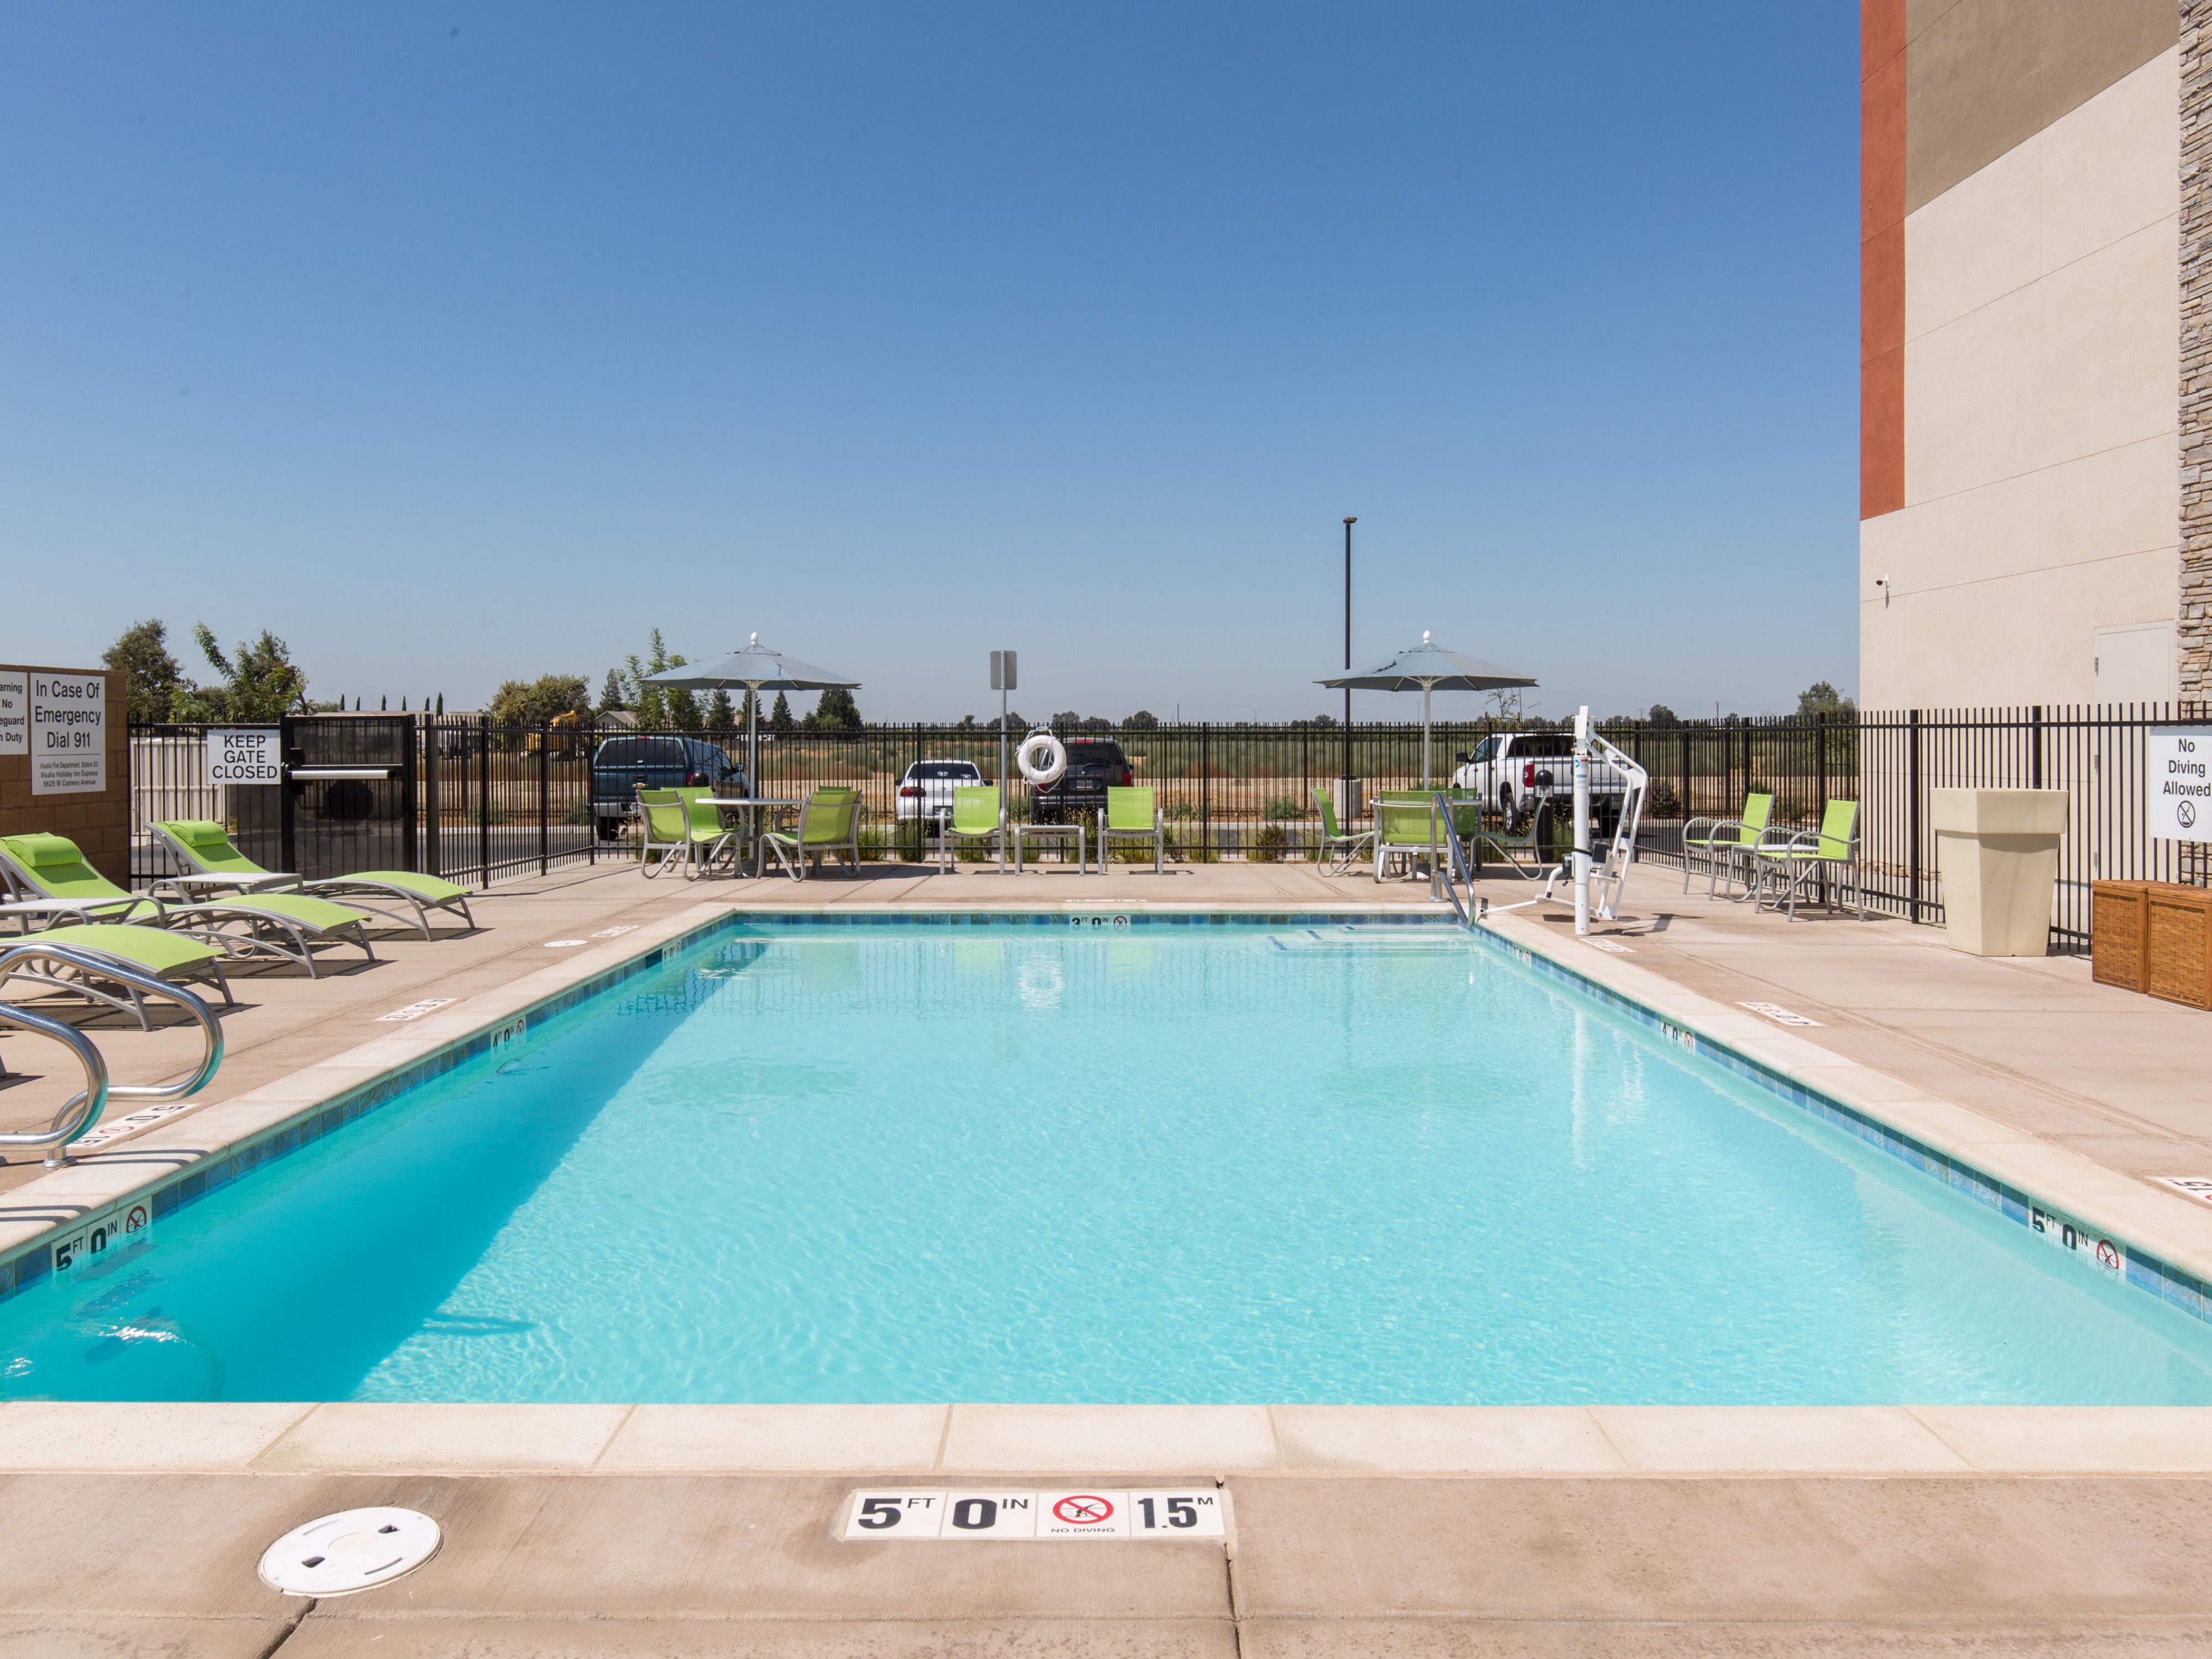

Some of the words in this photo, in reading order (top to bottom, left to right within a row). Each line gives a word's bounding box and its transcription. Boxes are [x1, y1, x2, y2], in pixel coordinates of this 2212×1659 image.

[0, 682, 23, 694] arning
[36, 680, 47, 697] In
[52, 680, 82, 698] Case
[86, 682, 100, 698] Of
[2, 699, 13, 708] No
[0, 716, 25, 727] eguard
[35, 706, 101, 726] Emergency
[6, 732, 23, 744] Duty
[47, 731, 70, 748] Dial
[74, 732, 90, 748] 911
[225, 734, 266, 748] KEEP
[2178, 738, 2195, 753] No
[224, 750, 266, 763] GATE
[212, 765, 278, 779] CLOSED
[2168, 760, 2206, 778] Diving
[2163, 781, 2211, 797] Allowed
[2032, 1206, 2045, 1233] 5
[2046, 1214, 2056, 1229] FT
[2062, 1223, 2077, 1250] 0
[2078, 1230, 2088, 1247] IN
[56, 1243, 72, 1271] 5
[73, 1237, 84, 1254] FT
[91, 1227, 106, 1254] 0
[108, 1220, 117, 1237] IN
[858, 1498, 902, 1530] 5
[907, 1498, 936, 1509] FT
[952, 1498, 997, 1530] 0
[1002, 1498, 1029, 1509] IN
[1138, 1497, 1198, 1529] 1.5
[1198, 1496, 1214, 1506] M
